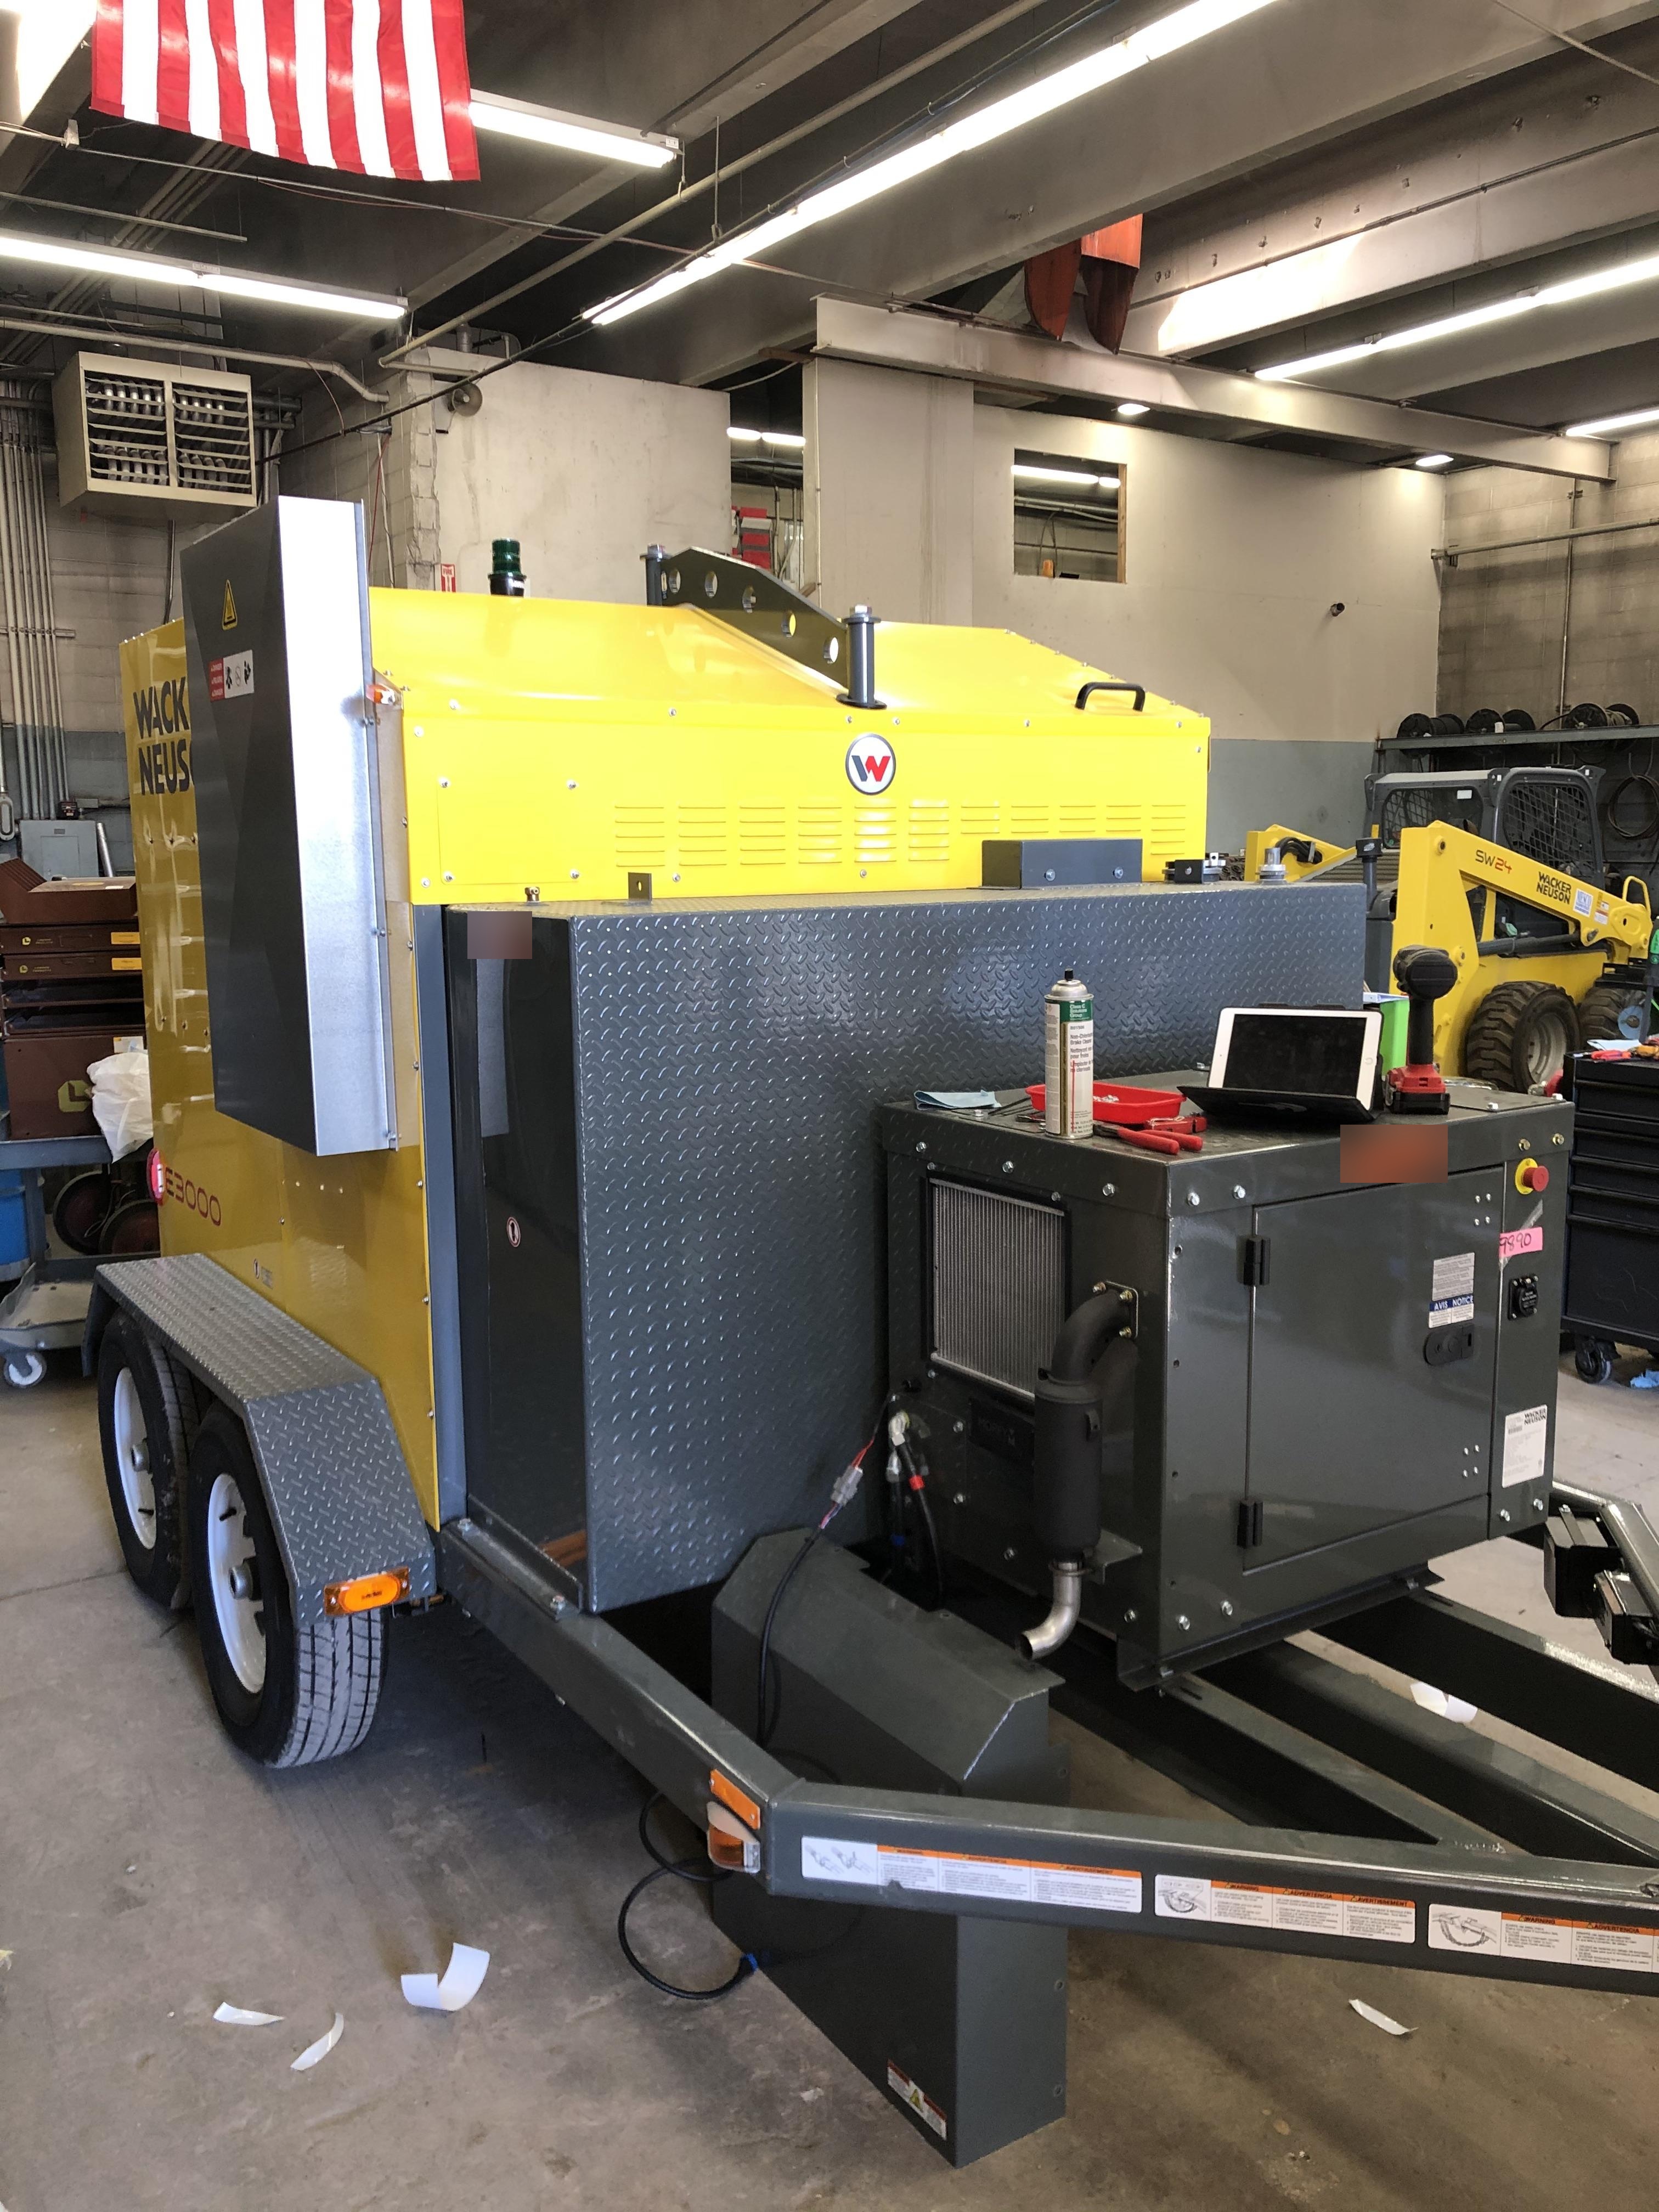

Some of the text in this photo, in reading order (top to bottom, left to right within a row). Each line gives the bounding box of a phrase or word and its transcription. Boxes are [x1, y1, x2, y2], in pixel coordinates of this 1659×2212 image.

[133, 676, 189, 739] WACK
[138, 738, 195, 796] NEUS
[1475, 849, 1512, 874] SW24
[1536, 882, 1571, 905] NEUSON
[1538, 871, 1572, 894] WACKER
[1434, 1295, 1474, 1311] AVIS NOTICE
[1525, 1917, 1556, 1925] WARNING
[1594, 1925, 1640, 1934] ADVERTENCIA
